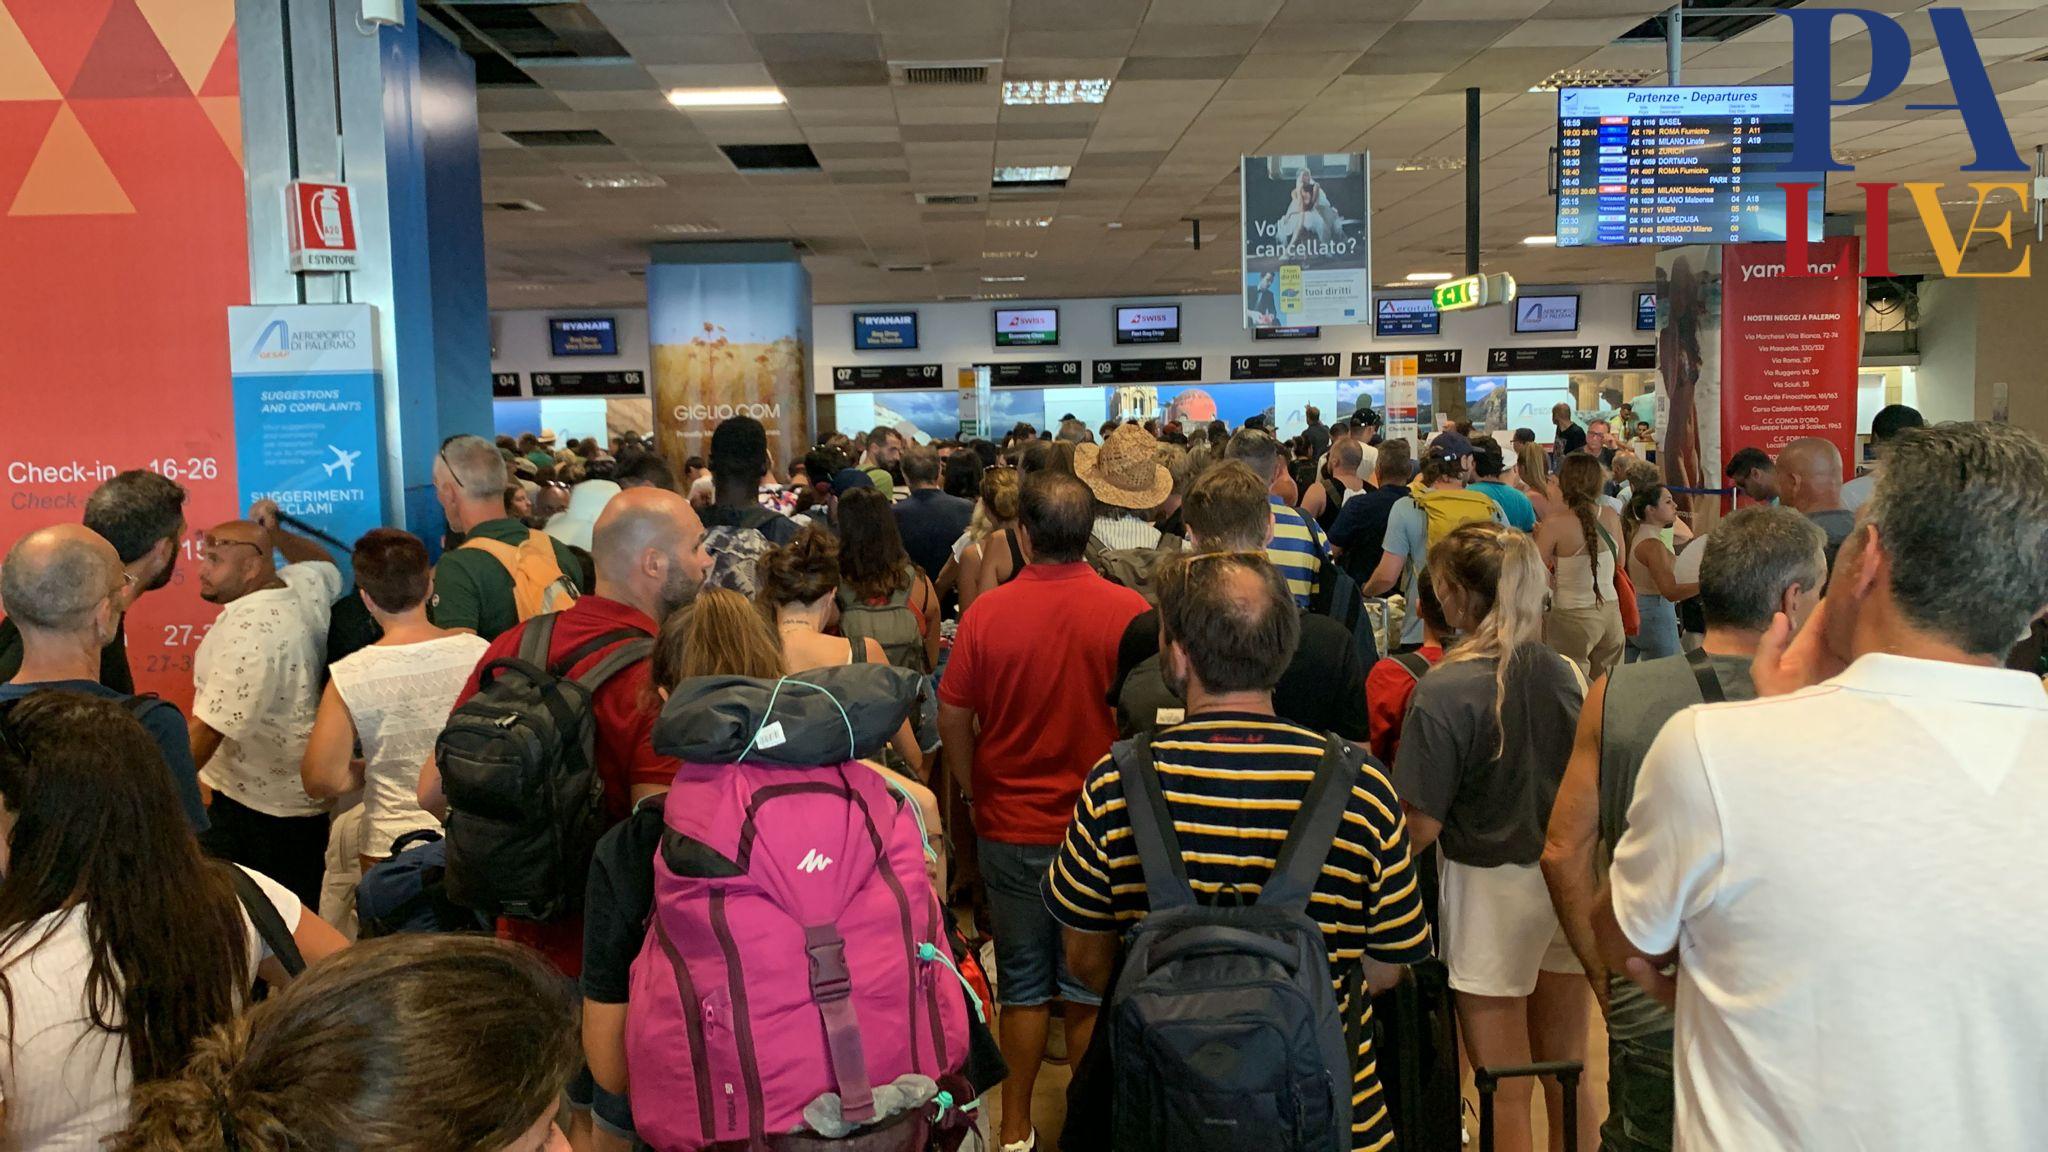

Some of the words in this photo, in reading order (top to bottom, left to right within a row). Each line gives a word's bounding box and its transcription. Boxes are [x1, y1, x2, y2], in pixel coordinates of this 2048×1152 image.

[1627, 92, 1680, 103] Partenze
[1692, 92, 1758, 104] Departures
[1256, 238, 1357, 257] cancellato?
[308, 254, 356, 265] ESTINTORE
[1326, 287, 1351, 295] diritti
[562, 321, 610, 331] RYANAIR
[865, 316, 912, 325] RYANAIR
[292, 330, 356, 340] AEROPORTO
[305, 340, 356, 350] PALERMO
[1358, 355, 1370, 367] 11
[1443, 352, 1455, 363] 11
[1494, 352, 1507, 362] 12
[1579, 348, 1592, 359] 12
[1614, 349, 1627, 360] 13
[1097, 363, 1111, 374] 09
[1182, 360, 1197, 370] 09
[1236, 358, 1249, 369] 10
[1321, 355, 1335, 366] 10
[837, 368, 851, 380] 07
[923, 366, 938, 378] 07
[1062, 363, 1076, 374] 08
[500, 375, 515, 386] 04
[624, 373, 640, 384] 05
[260, 390, 340, 401] SUGGESTIONS
[261, 403, 286, 413] AND
[290, 401, 362, 412] COMPLAINTS
[674, 404, 780, 420] GIGLIO.COM
[8, 460, 117, 484] Check-in
[150, 458, 218, 480] 16-26
